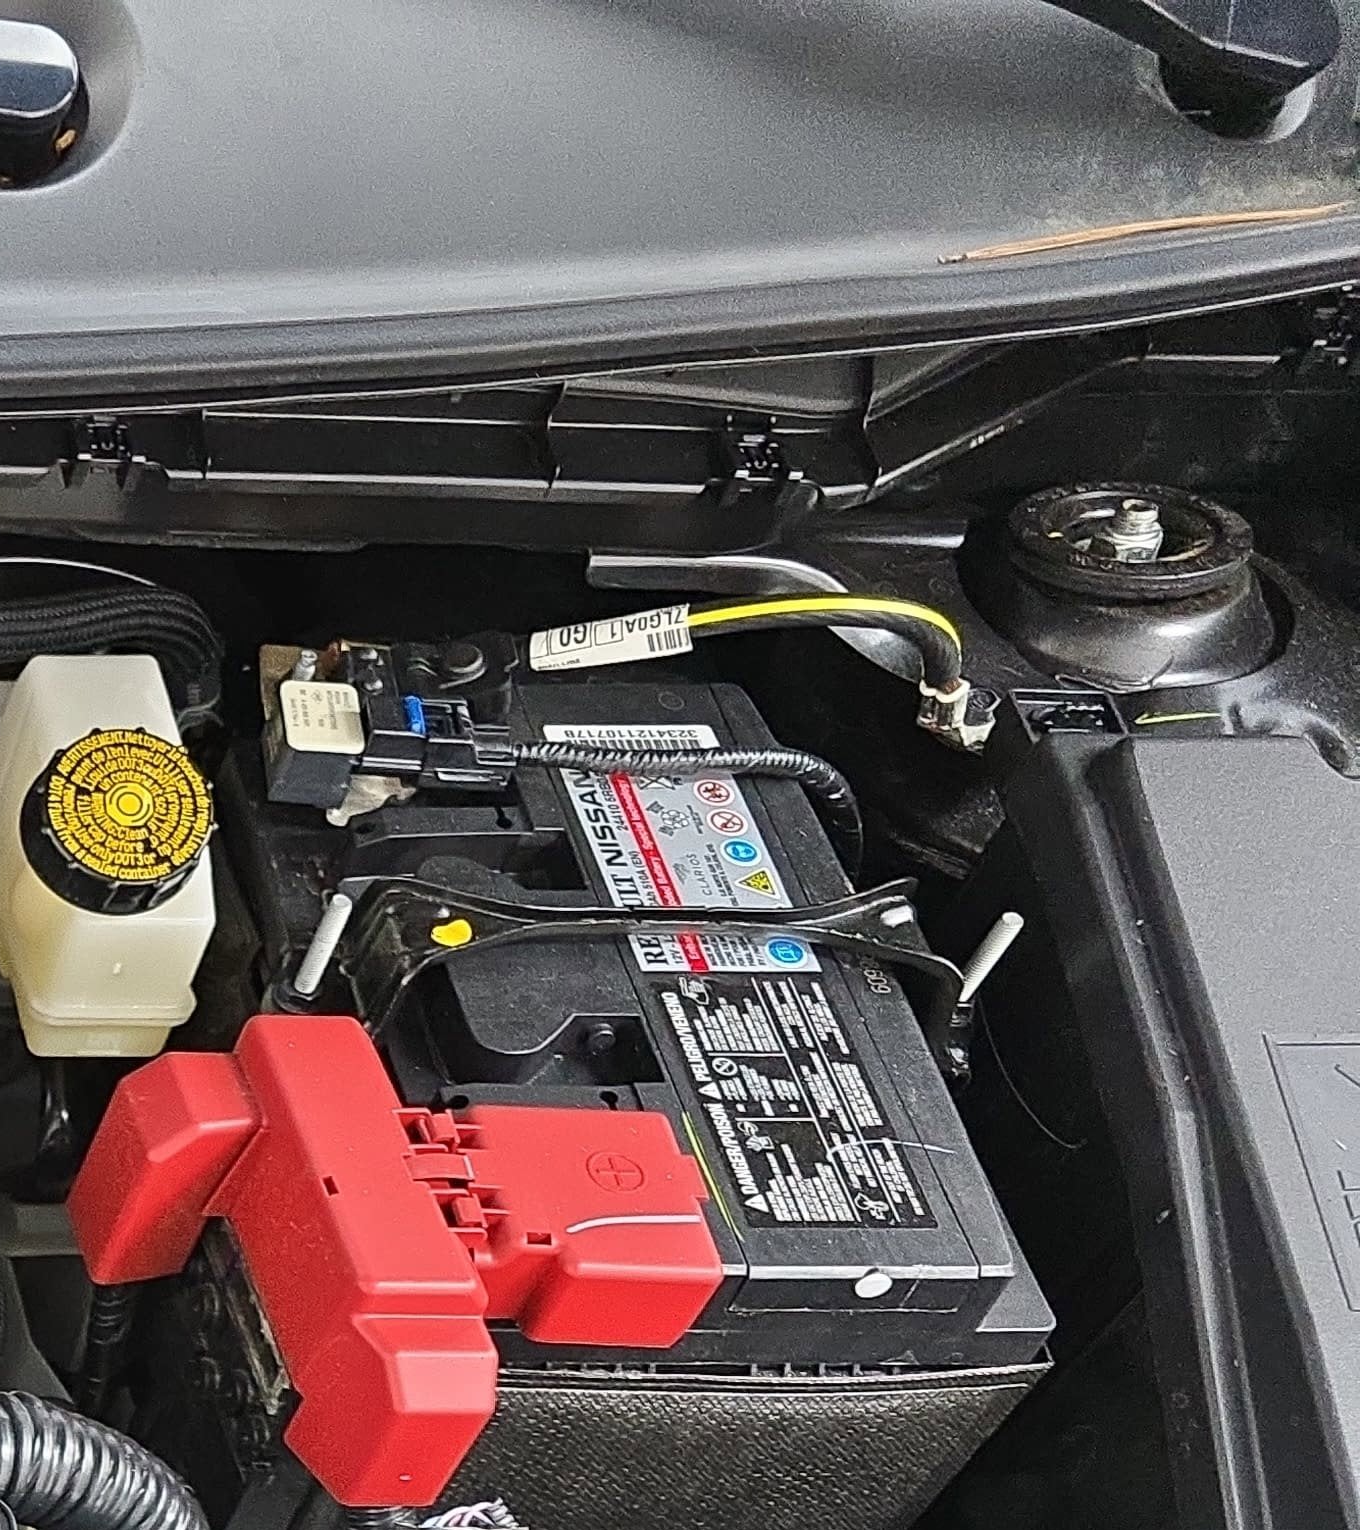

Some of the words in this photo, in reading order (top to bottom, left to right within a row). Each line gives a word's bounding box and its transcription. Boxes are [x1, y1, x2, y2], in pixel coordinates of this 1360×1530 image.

[573, 769, 627, 867] NISSAN
[611, 805, 629, 831] 24410
[119, 863, 170, 879] container
[686, 853, 713, 896] CLARIOS
[612, 874, 668, 965] REULT
[661, 991, 712, 1082] PELIGRO/VENENO
[704, 1103, 759, 1196] DANGER/POISON
